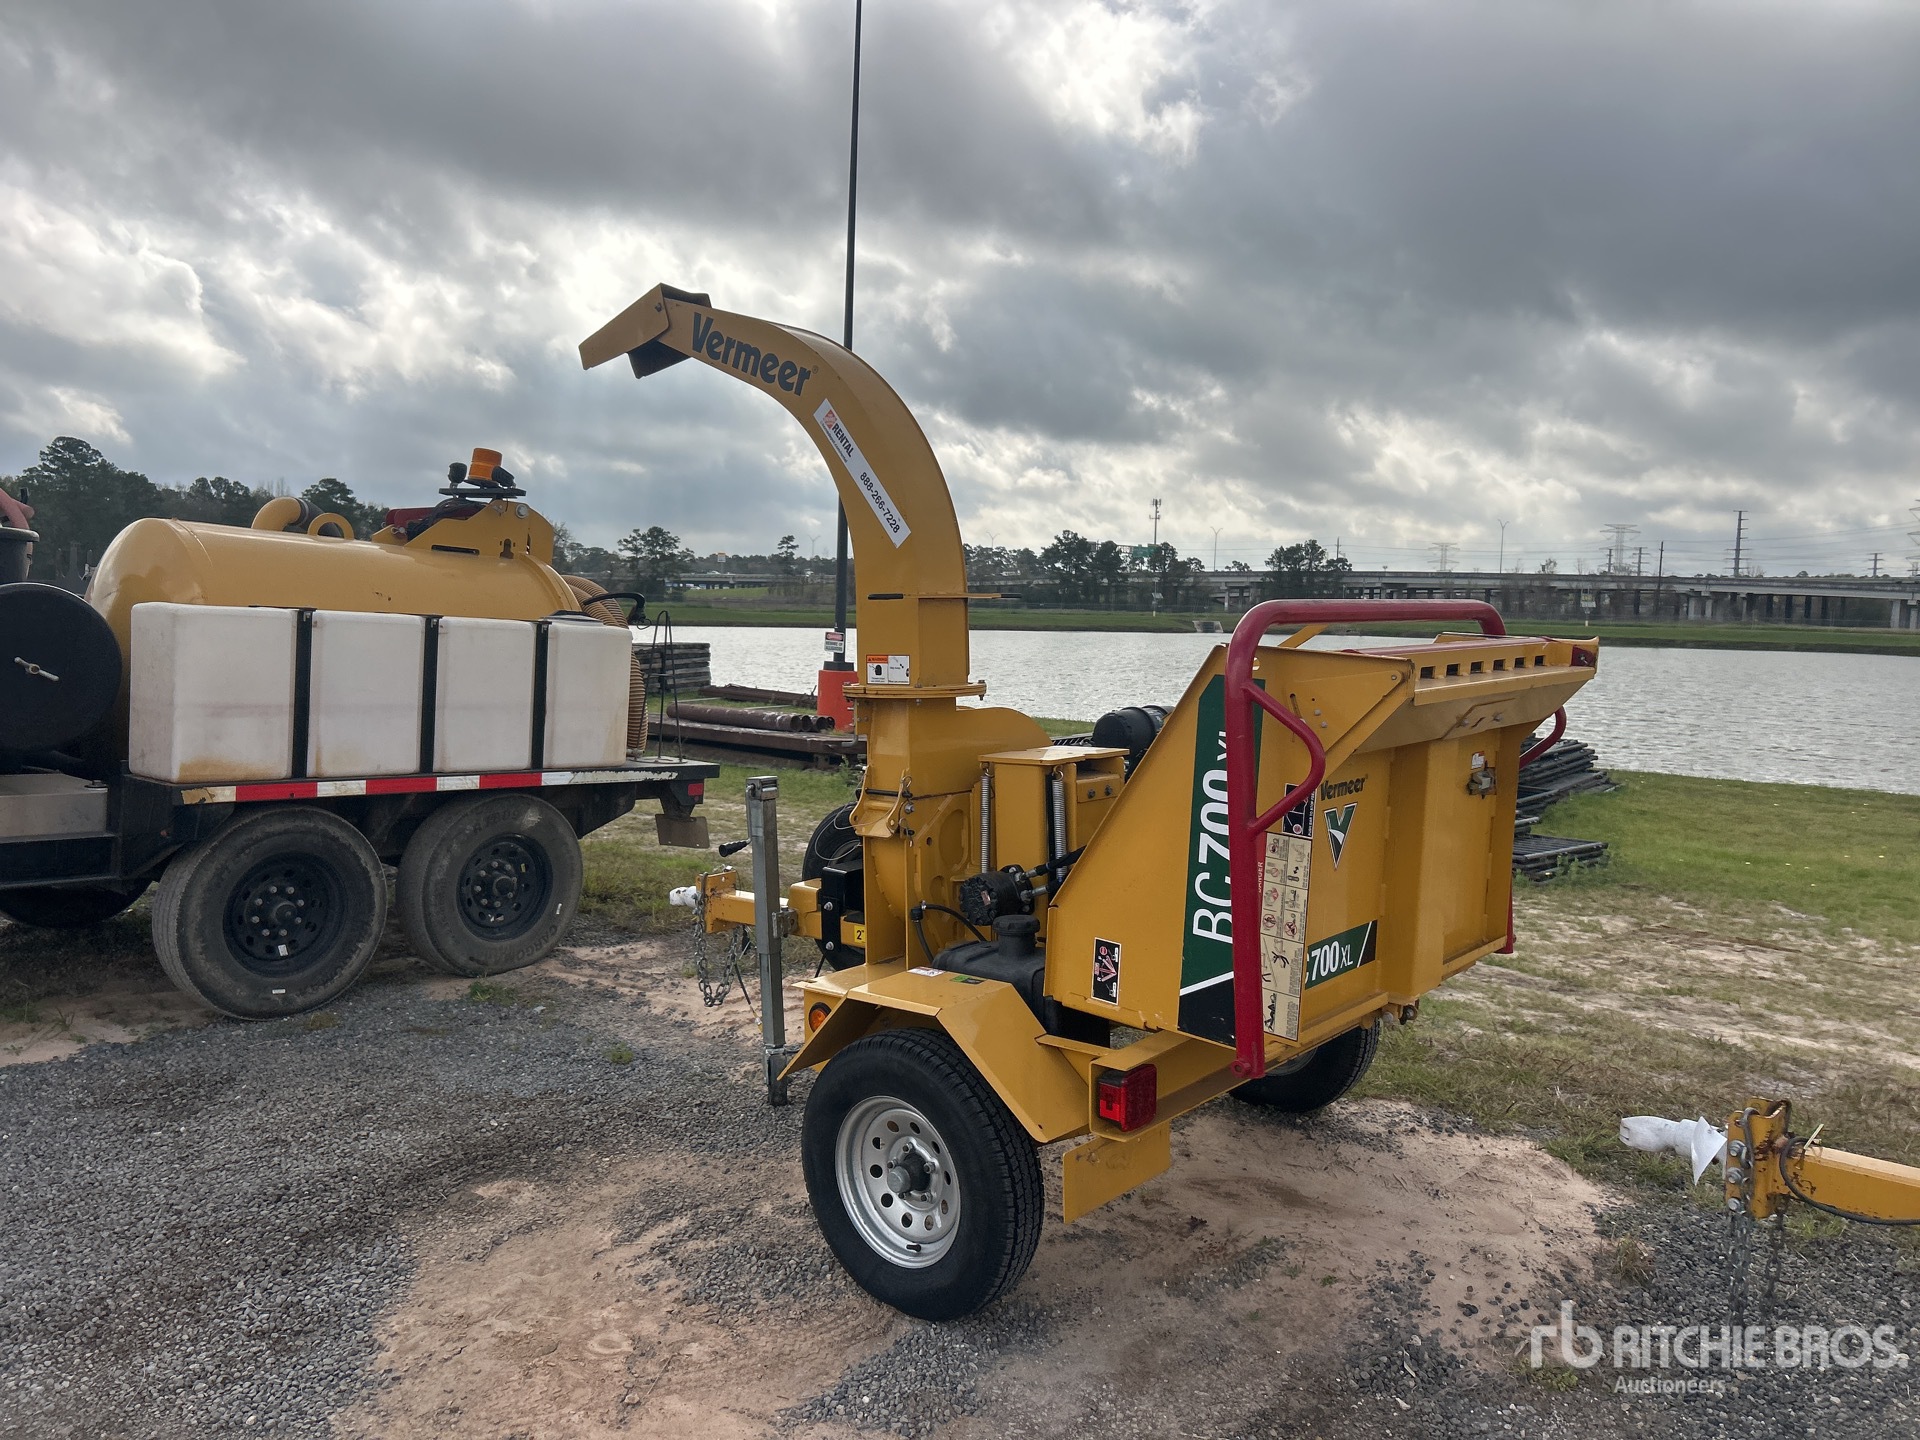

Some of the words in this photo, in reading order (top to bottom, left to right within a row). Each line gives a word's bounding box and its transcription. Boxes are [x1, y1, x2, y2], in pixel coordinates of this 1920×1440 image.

[692, 312, 812, 396] Vermeer
[832, 423, 855, 457] RENTAL
[859, 472, 900, 533] 888-266-7228
[1321, 777, 1366, 801] Vermeer
